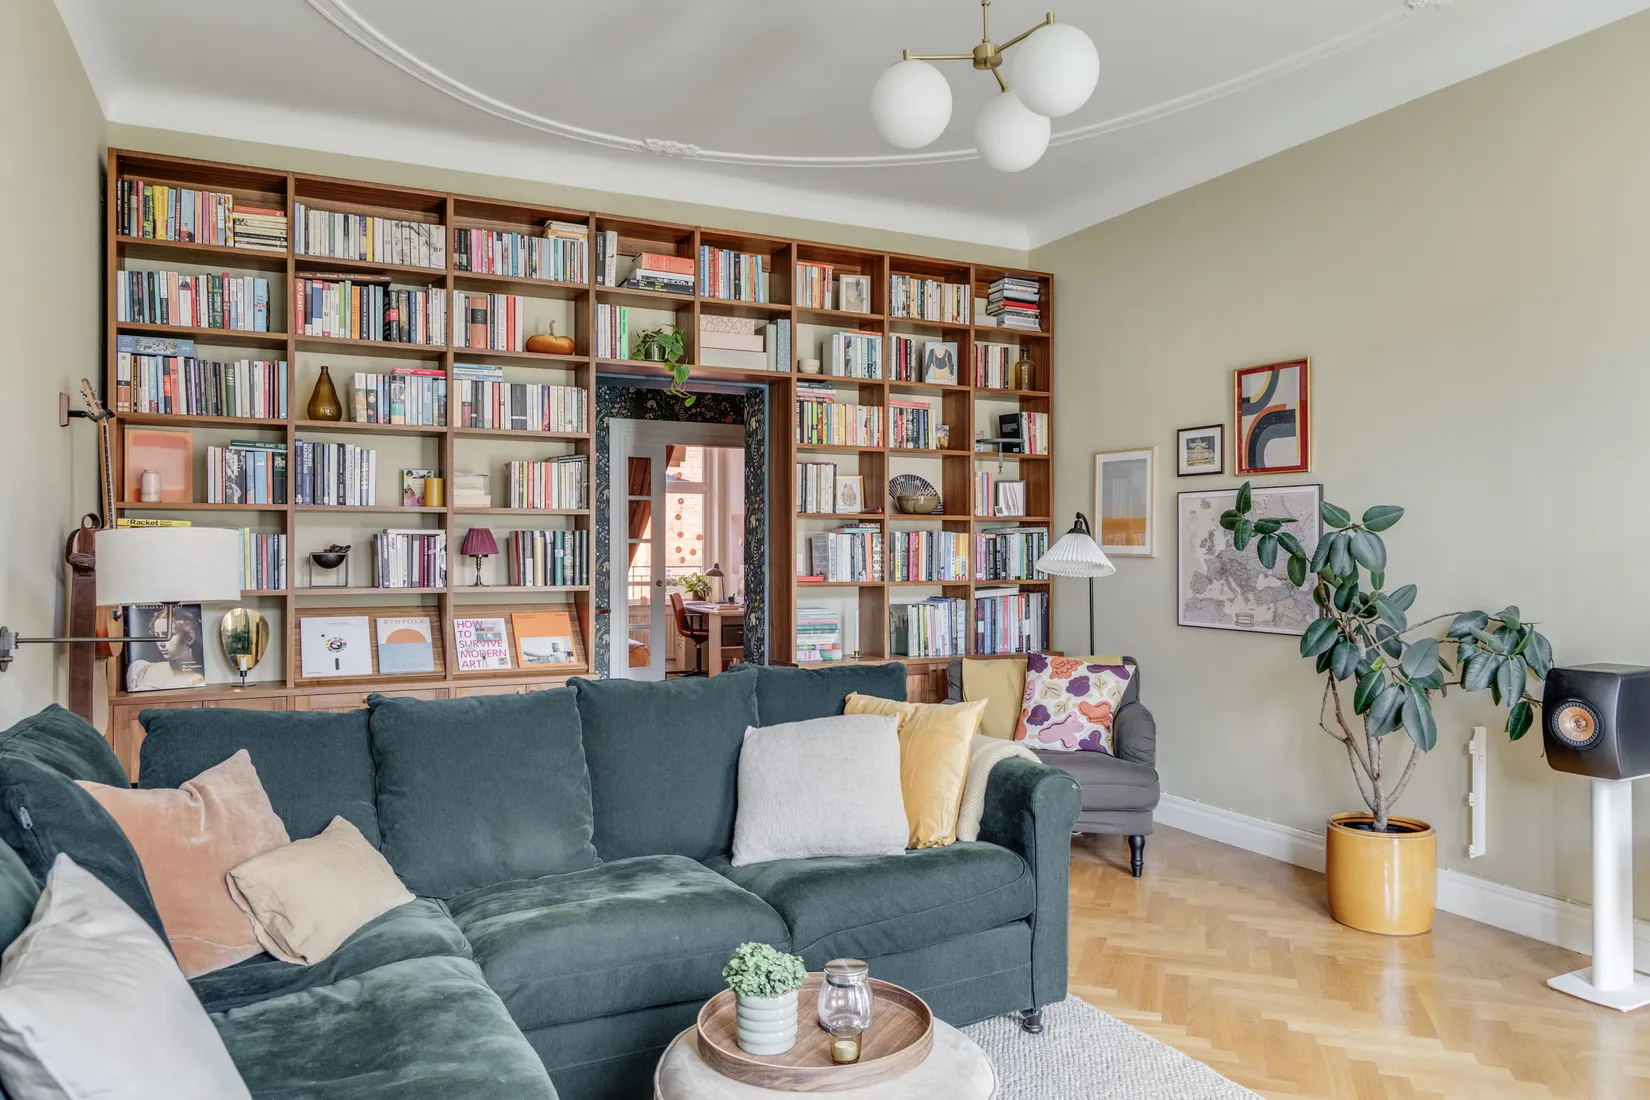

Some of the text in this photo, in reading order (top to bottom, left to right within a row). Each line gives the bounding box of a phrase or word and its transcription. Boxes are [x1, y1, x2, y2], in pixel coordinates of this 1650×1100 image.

[565, 533, 573, 566] Amos Oz
[872, 538, 882, 578] 2666
[456, 620, 483, 628] HOW
[458, 630, 472, 638] TO
[459, 640, 503, 648] SURVIVE
[460, 649, 507, 658] MODERN
[462, 660, 481, 668] ART
